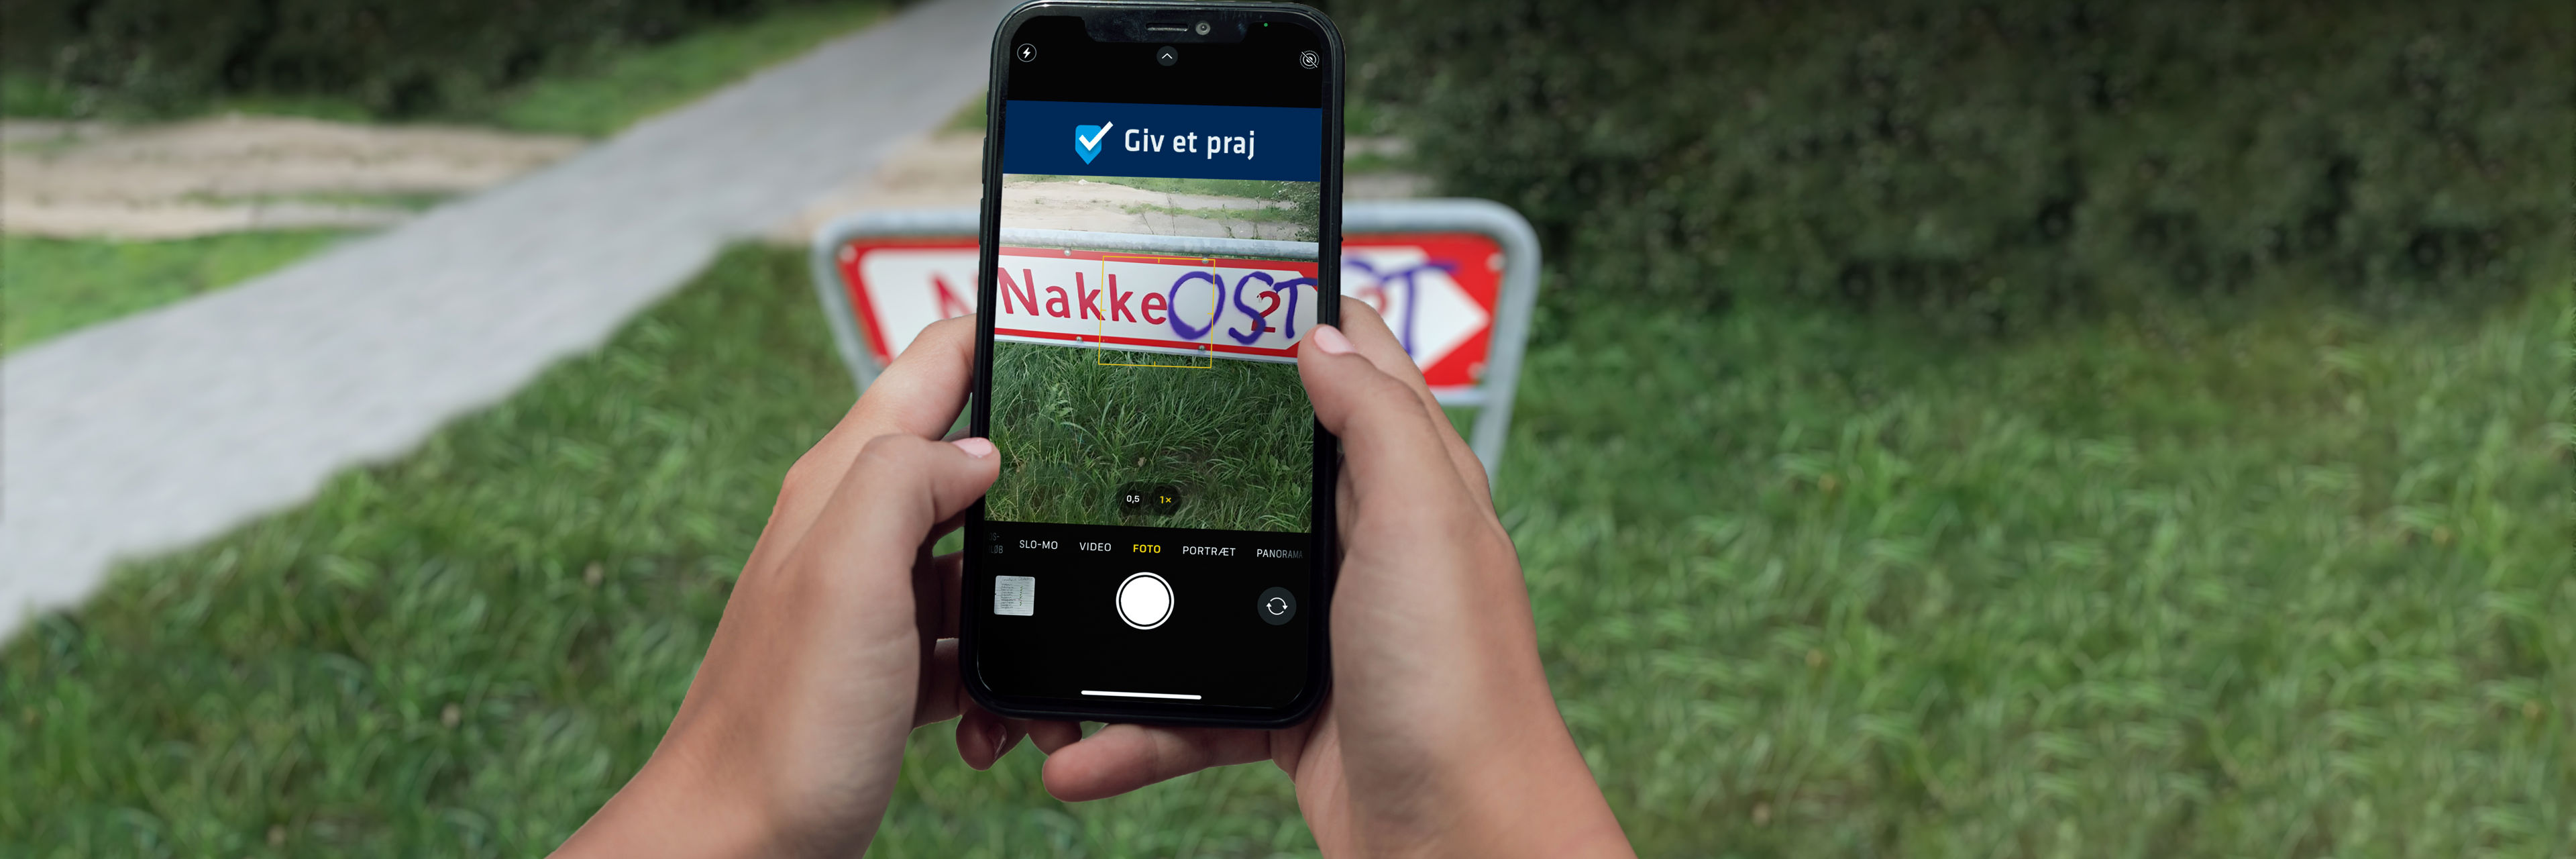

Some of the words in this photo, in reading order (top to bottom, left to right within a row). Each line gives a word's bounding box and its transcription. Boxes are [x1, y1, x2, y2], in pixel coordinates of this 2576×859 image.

[1125, 128, 1165, 152] Giv
[1173, 132, 1197, 153] et
[1207, 130, 1254, 160] praj
[997, 266, 1167, 325] Nakke
[1168, 270, 1318, 345] OST
[1126, 495, 1140, 504] 0,5
[1019, 540, 1058, 550] SLO-MO
[1079, 542, 1112, 552] VIDEO
[1132, 544, 1161, 554] FOTO
[1183, 546, 1236, 556] PORTRÆT
[1256, 548, 1303, 558] PANORAMA
